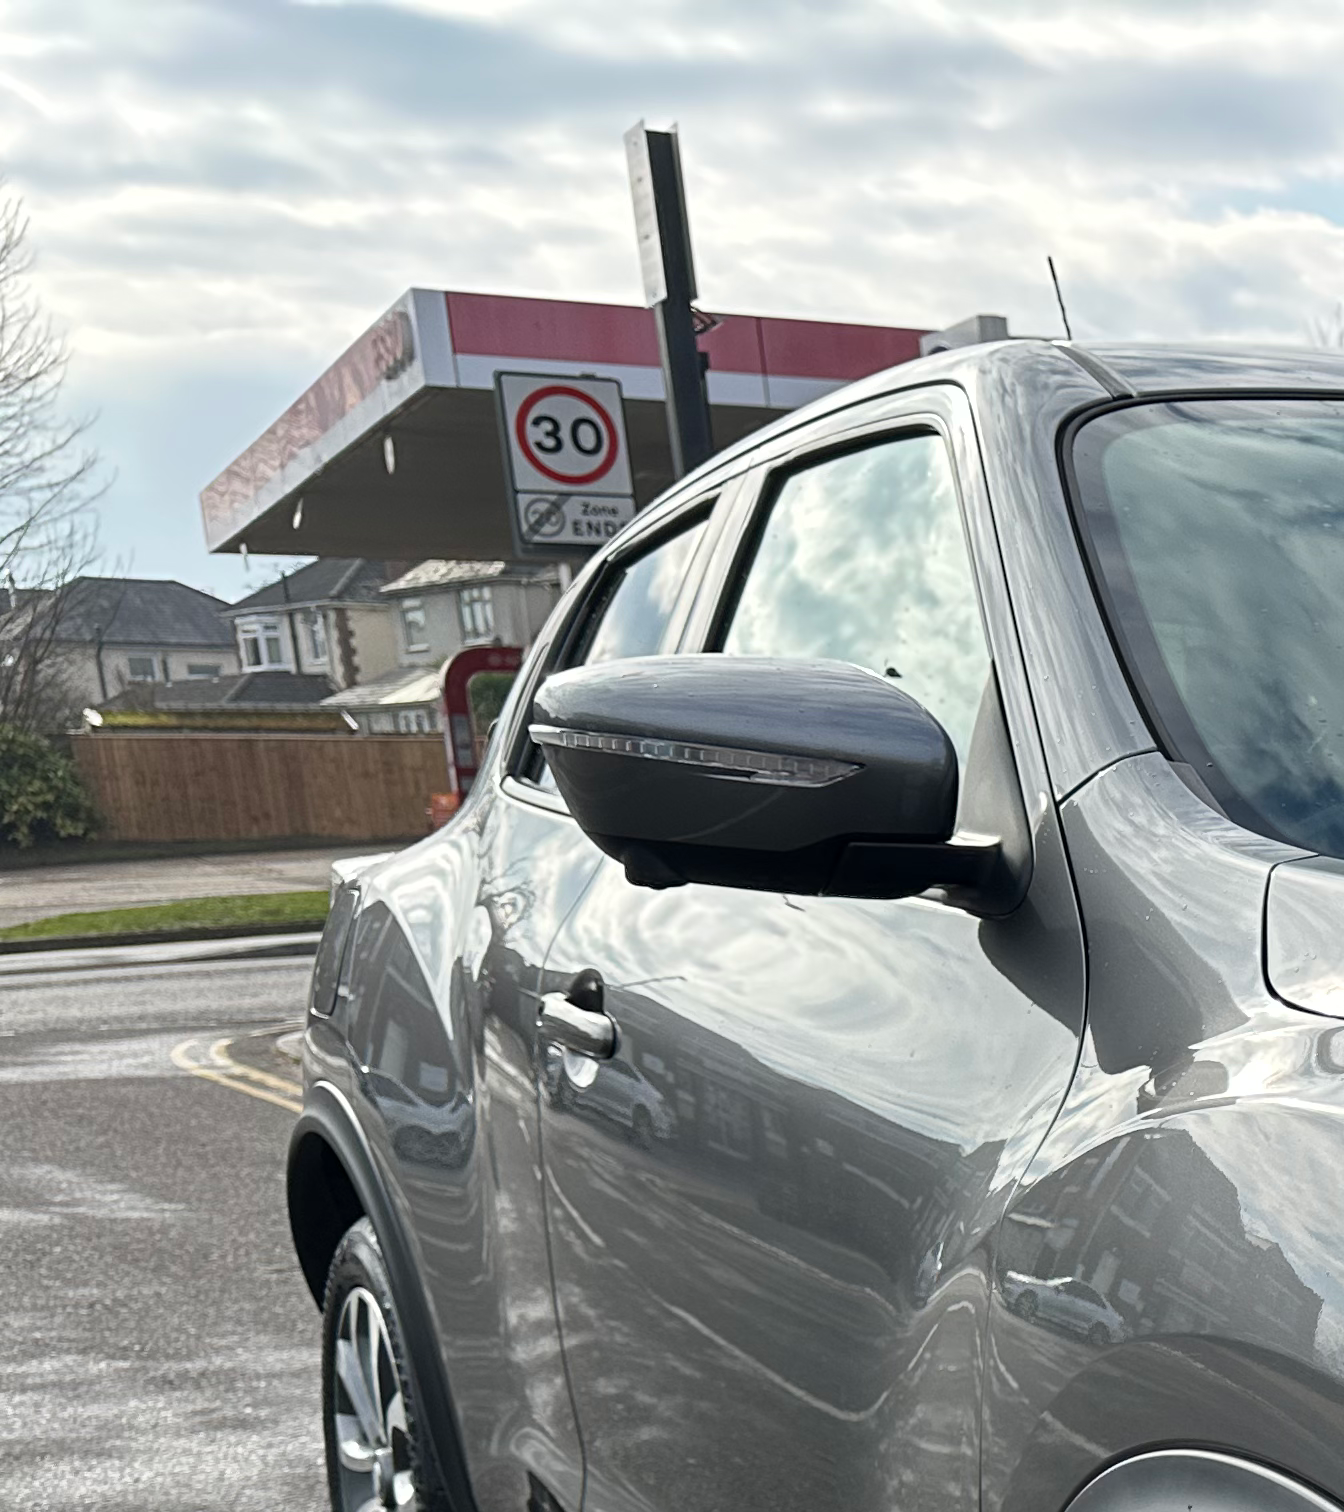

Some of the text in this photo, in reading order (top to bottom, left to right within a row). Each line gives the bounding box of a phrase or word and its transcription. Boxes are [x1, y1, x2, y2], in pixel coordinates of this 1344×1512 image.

[531, 415, 602, 455] 30
[581, 503, 619, 517] Zone
[572, 520, 624, 537] END
